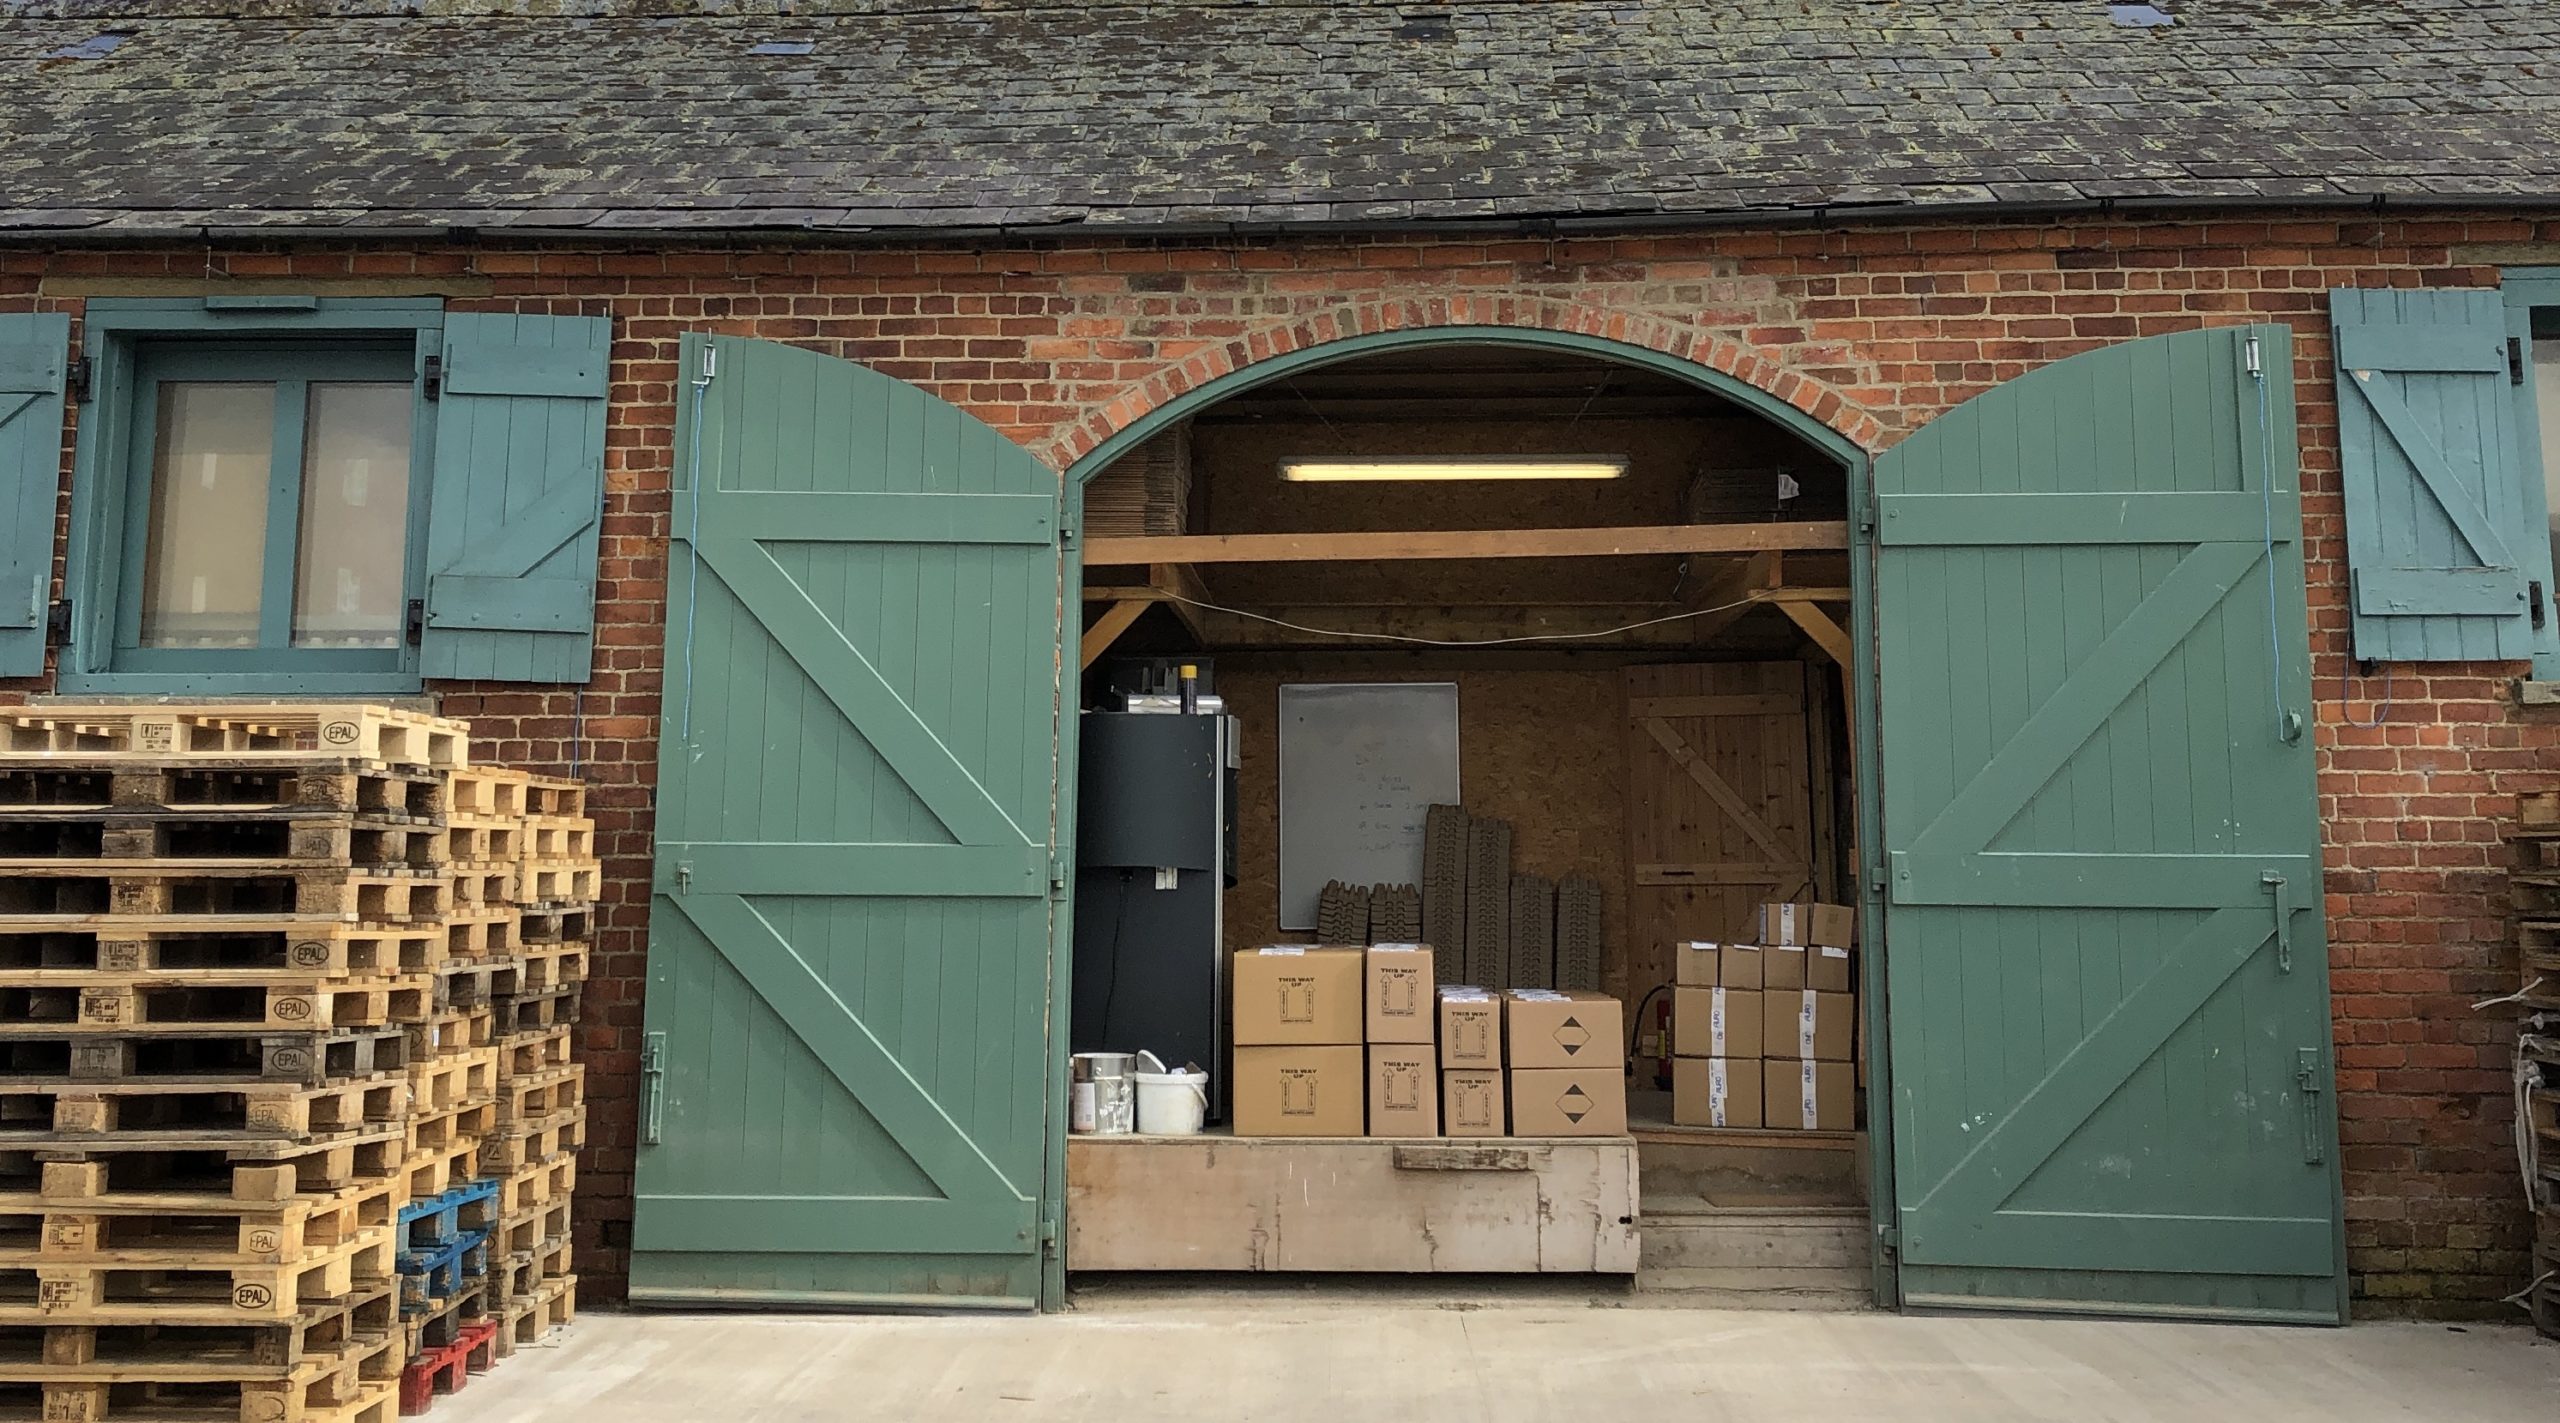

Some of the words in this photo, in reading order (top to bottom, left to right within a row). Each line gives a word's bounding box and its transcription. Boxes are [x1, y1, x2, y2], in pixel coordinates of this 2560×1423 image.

[329, 726, 354, 739] EPAL
[298, 947, 322, 961] EPAL
[278, 1002, 305, 1016] EPAL
[239, 1289, 266, 1303] EPAL
